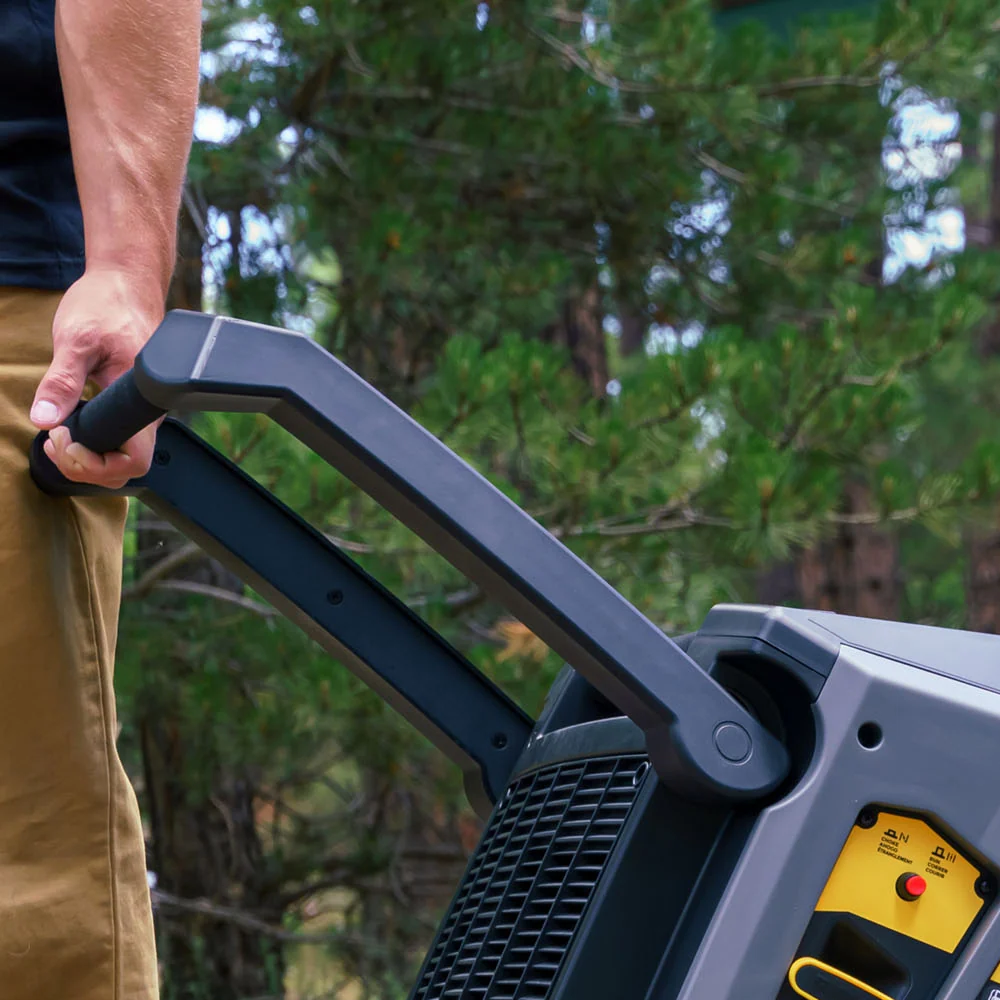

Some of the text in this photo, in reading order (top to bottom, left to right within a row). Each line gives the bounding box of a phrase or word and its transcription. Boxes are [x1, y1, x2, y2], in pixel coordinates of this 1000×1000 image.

[881, 836, 899, 847] CHOKE
[929, 856, 940, 864] RUN
[927, 862, 948, 874] CORRER
